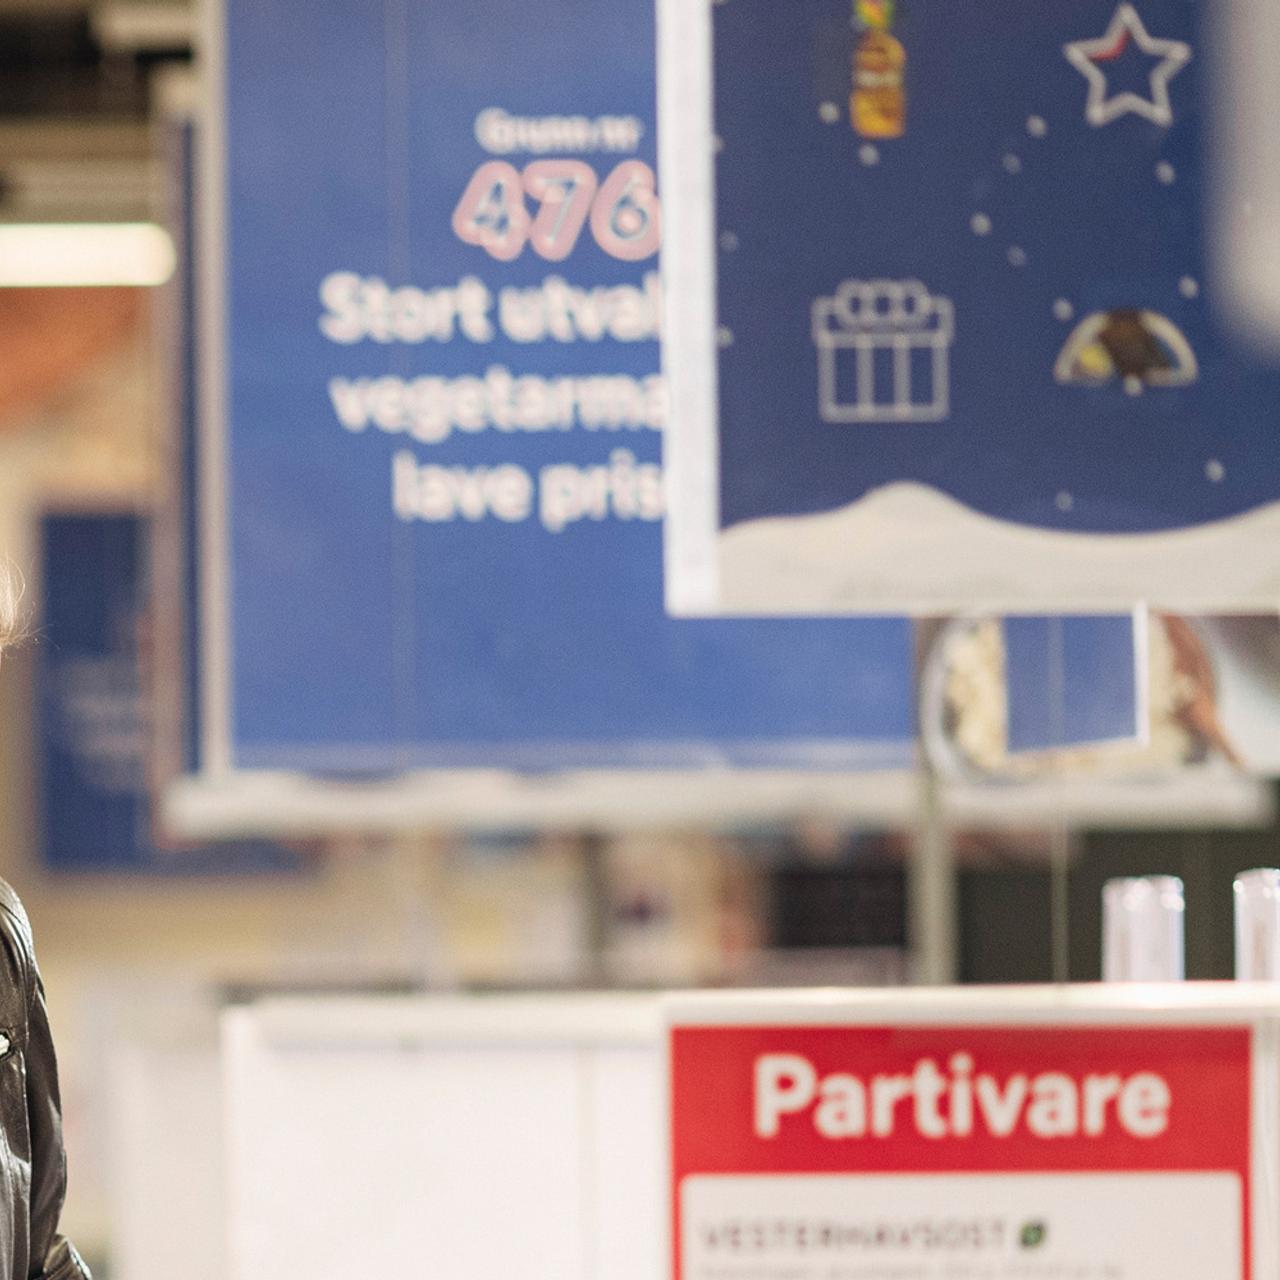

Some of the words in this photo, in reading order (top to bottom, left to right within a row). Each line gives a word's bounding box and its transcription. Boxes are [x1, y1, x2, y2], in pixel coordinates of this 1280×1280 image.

[451, 159, 661, 261] 476
[318, 270, 493, 344] Stort
[391, 448, 531, 522] lave
[753, 1052, 1171, 1139] Partivare
